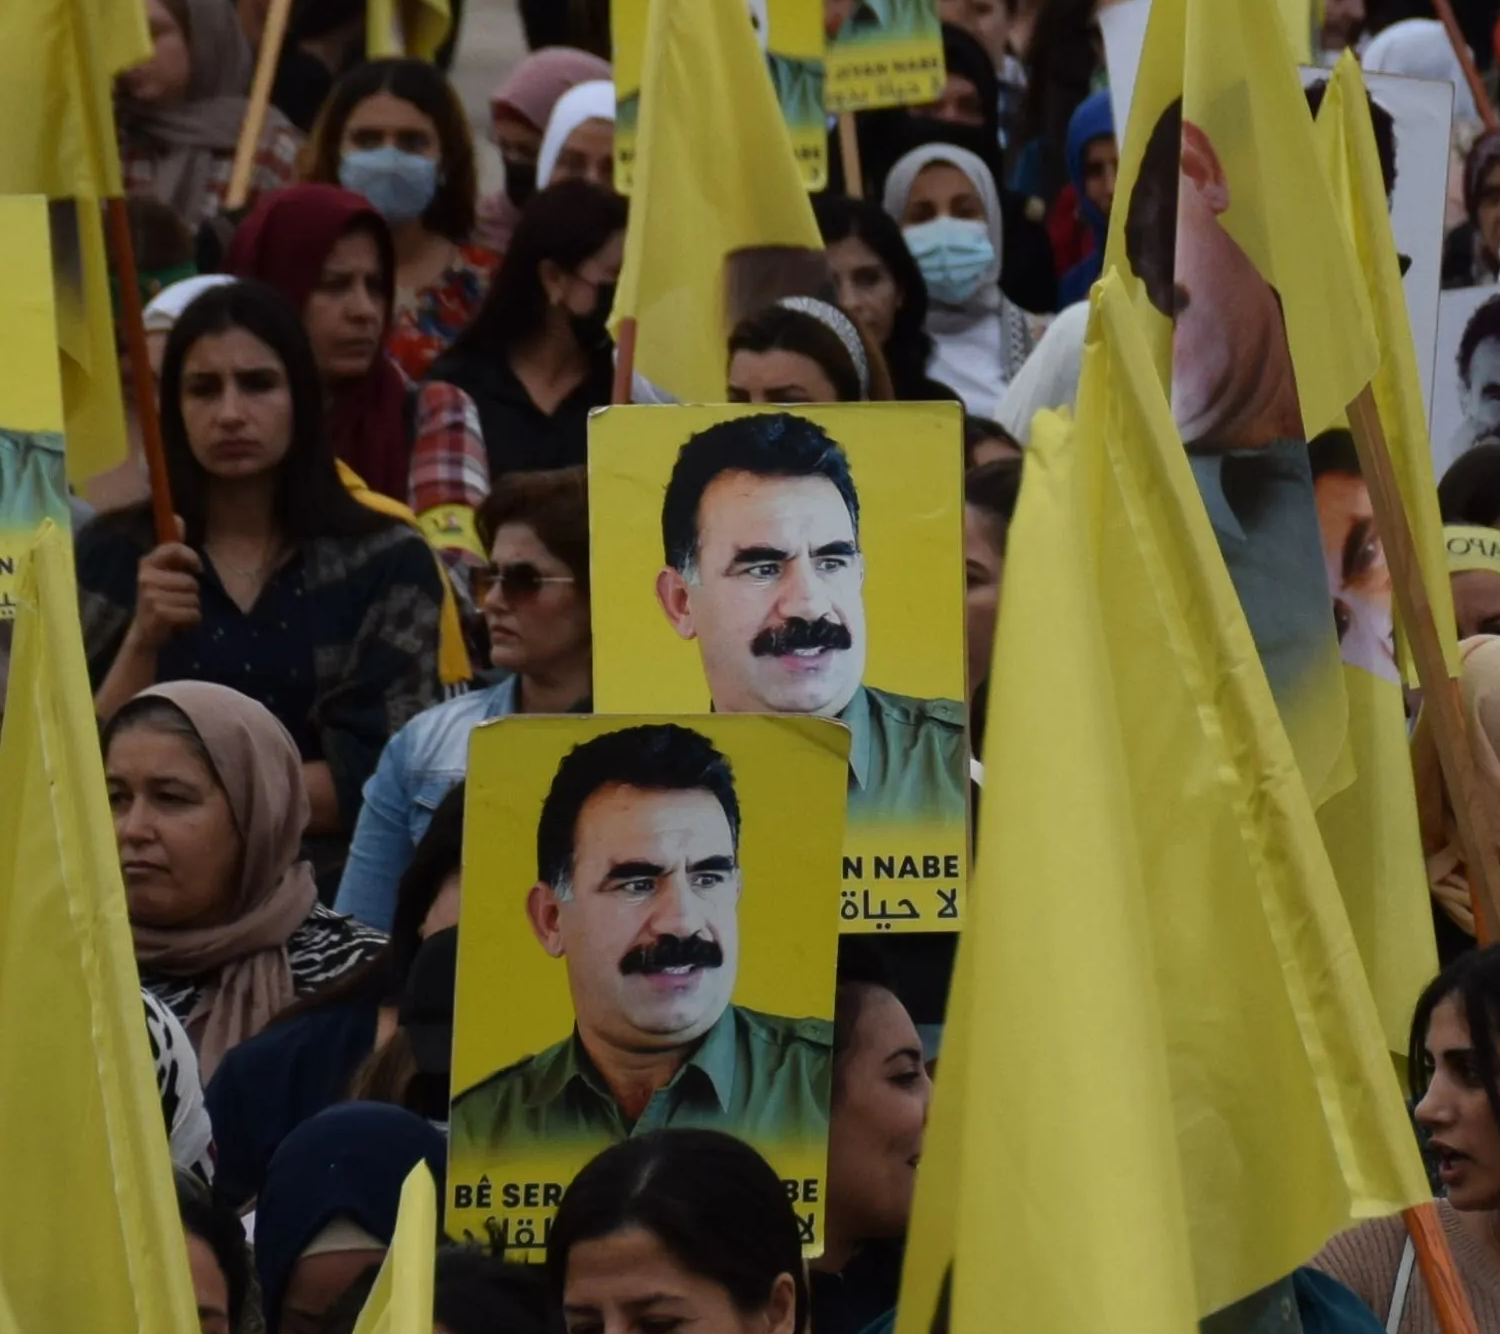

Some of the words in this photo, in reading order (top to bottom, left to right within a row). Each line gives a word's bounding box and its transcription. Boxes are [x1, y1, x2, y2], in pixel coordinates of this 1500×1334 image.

[873, 855, 959, 879] NABE
[840, 888, 920, 930] حياة
[936, 888, 958, 919] لا
[454, 1175, 492, 1209] BÊ
